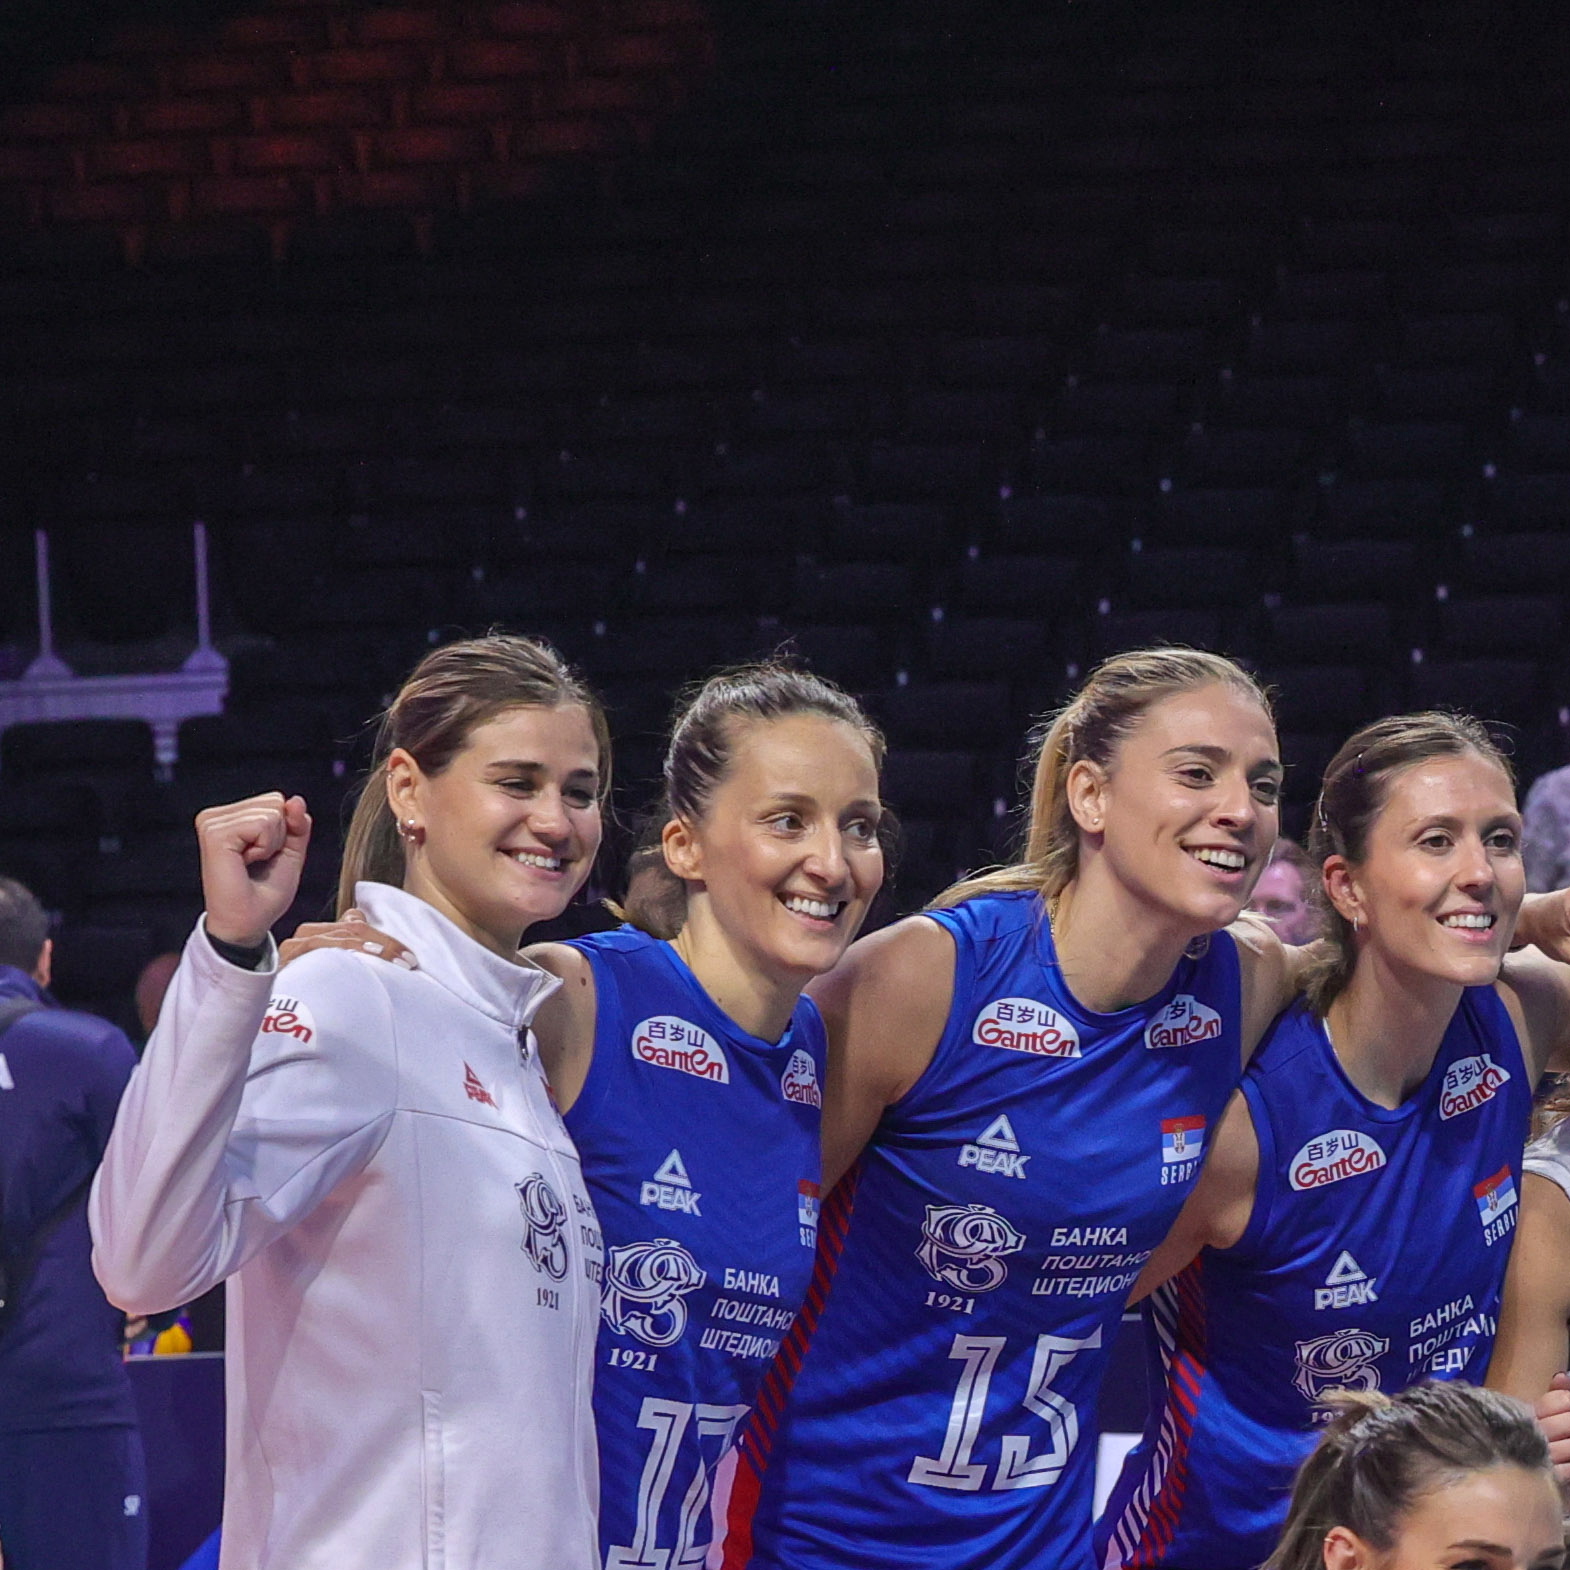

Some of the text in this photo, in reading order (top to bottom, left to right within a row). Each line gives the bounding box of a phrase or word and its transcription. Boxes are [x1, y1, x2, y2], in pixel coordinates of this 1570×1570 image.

[261, 1012, 312, 1043] ten
[996, 1002, 1057, 1028] 百岁山
[647, 1020, 706, 1049] 百岁山
[977, 1018, 1077, 1058] Ganten
[636, 1035, 724, 1082] Ganten
[958, 1144, 1031, 1179] PEAK
[1306, 1132, 1360, 1162] 百岁山
[1293, 1146, 1383, 1189] Ganten
[640, 1181, 702, 1217] PEAK
[1050, 1227, 1128, 1247] БАНКА
[1483, 1205, 1520, 1248] SERBI
[1041, 1248, 1154, 1271] ПОШТАНС
[536, 1287, 560, 1310] 1921
[723, 1267, 779, 1298] БАНКА
[1314, 1277, 1378, 1311] PEAK
[711, 1297, 795, 1332] ПОШТАНС
[924, 1290, 976, 1315] 1921
[1409, 1294, 1475, 1339] БАНКА
[607, 1347, 658, 1372] 1921
[907, 1323, 1103, 1491] 15
